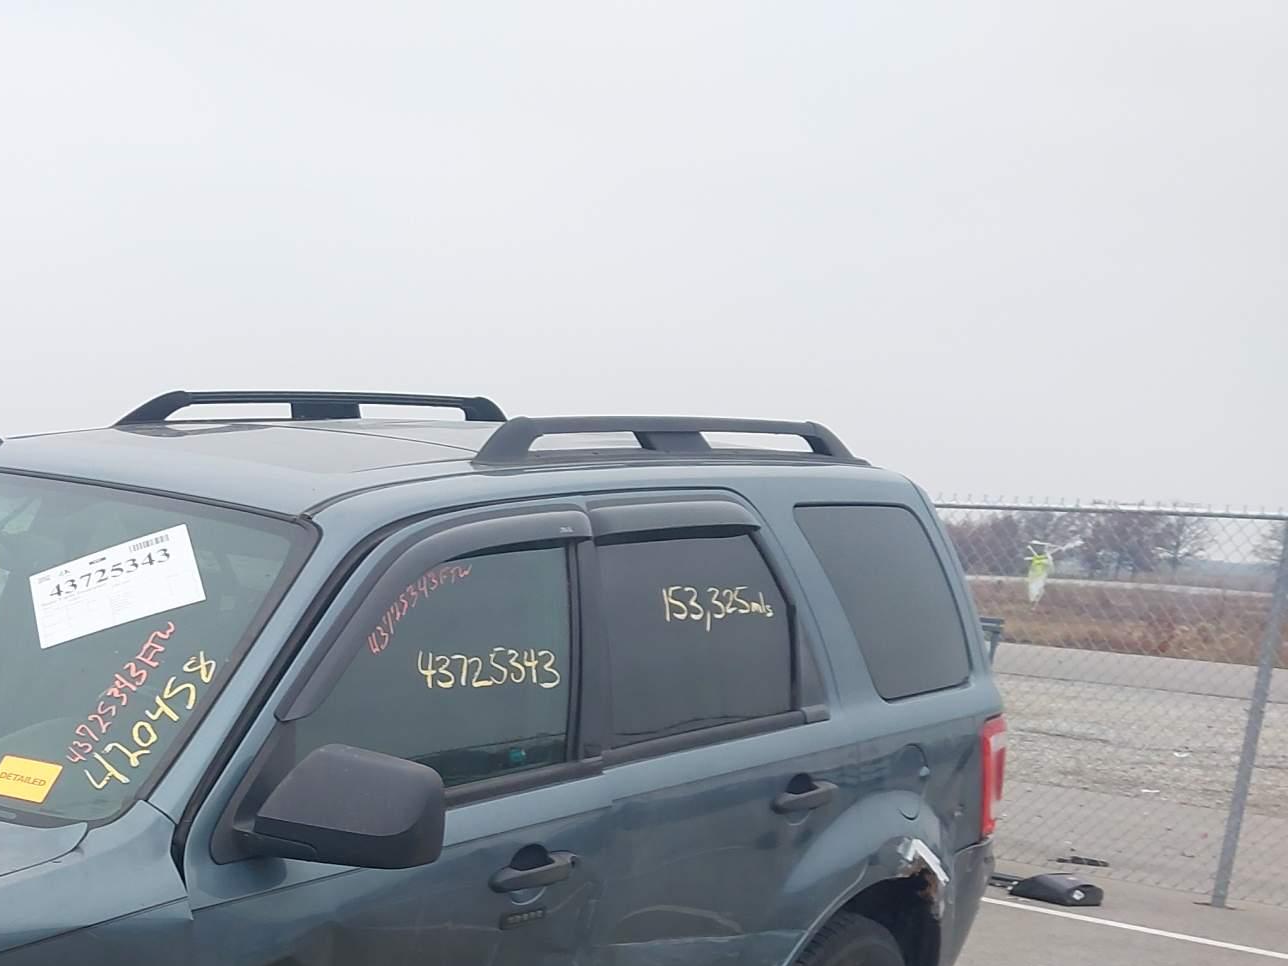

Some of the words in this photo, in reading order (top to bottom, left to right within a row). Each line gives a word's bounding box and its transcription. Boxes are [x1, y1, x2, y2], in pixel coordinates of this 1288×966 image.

[49, 548, 171, 598] 43725343
[417, 647, 561, 689] 43725343
[84, 650, 217, 789] 420458
